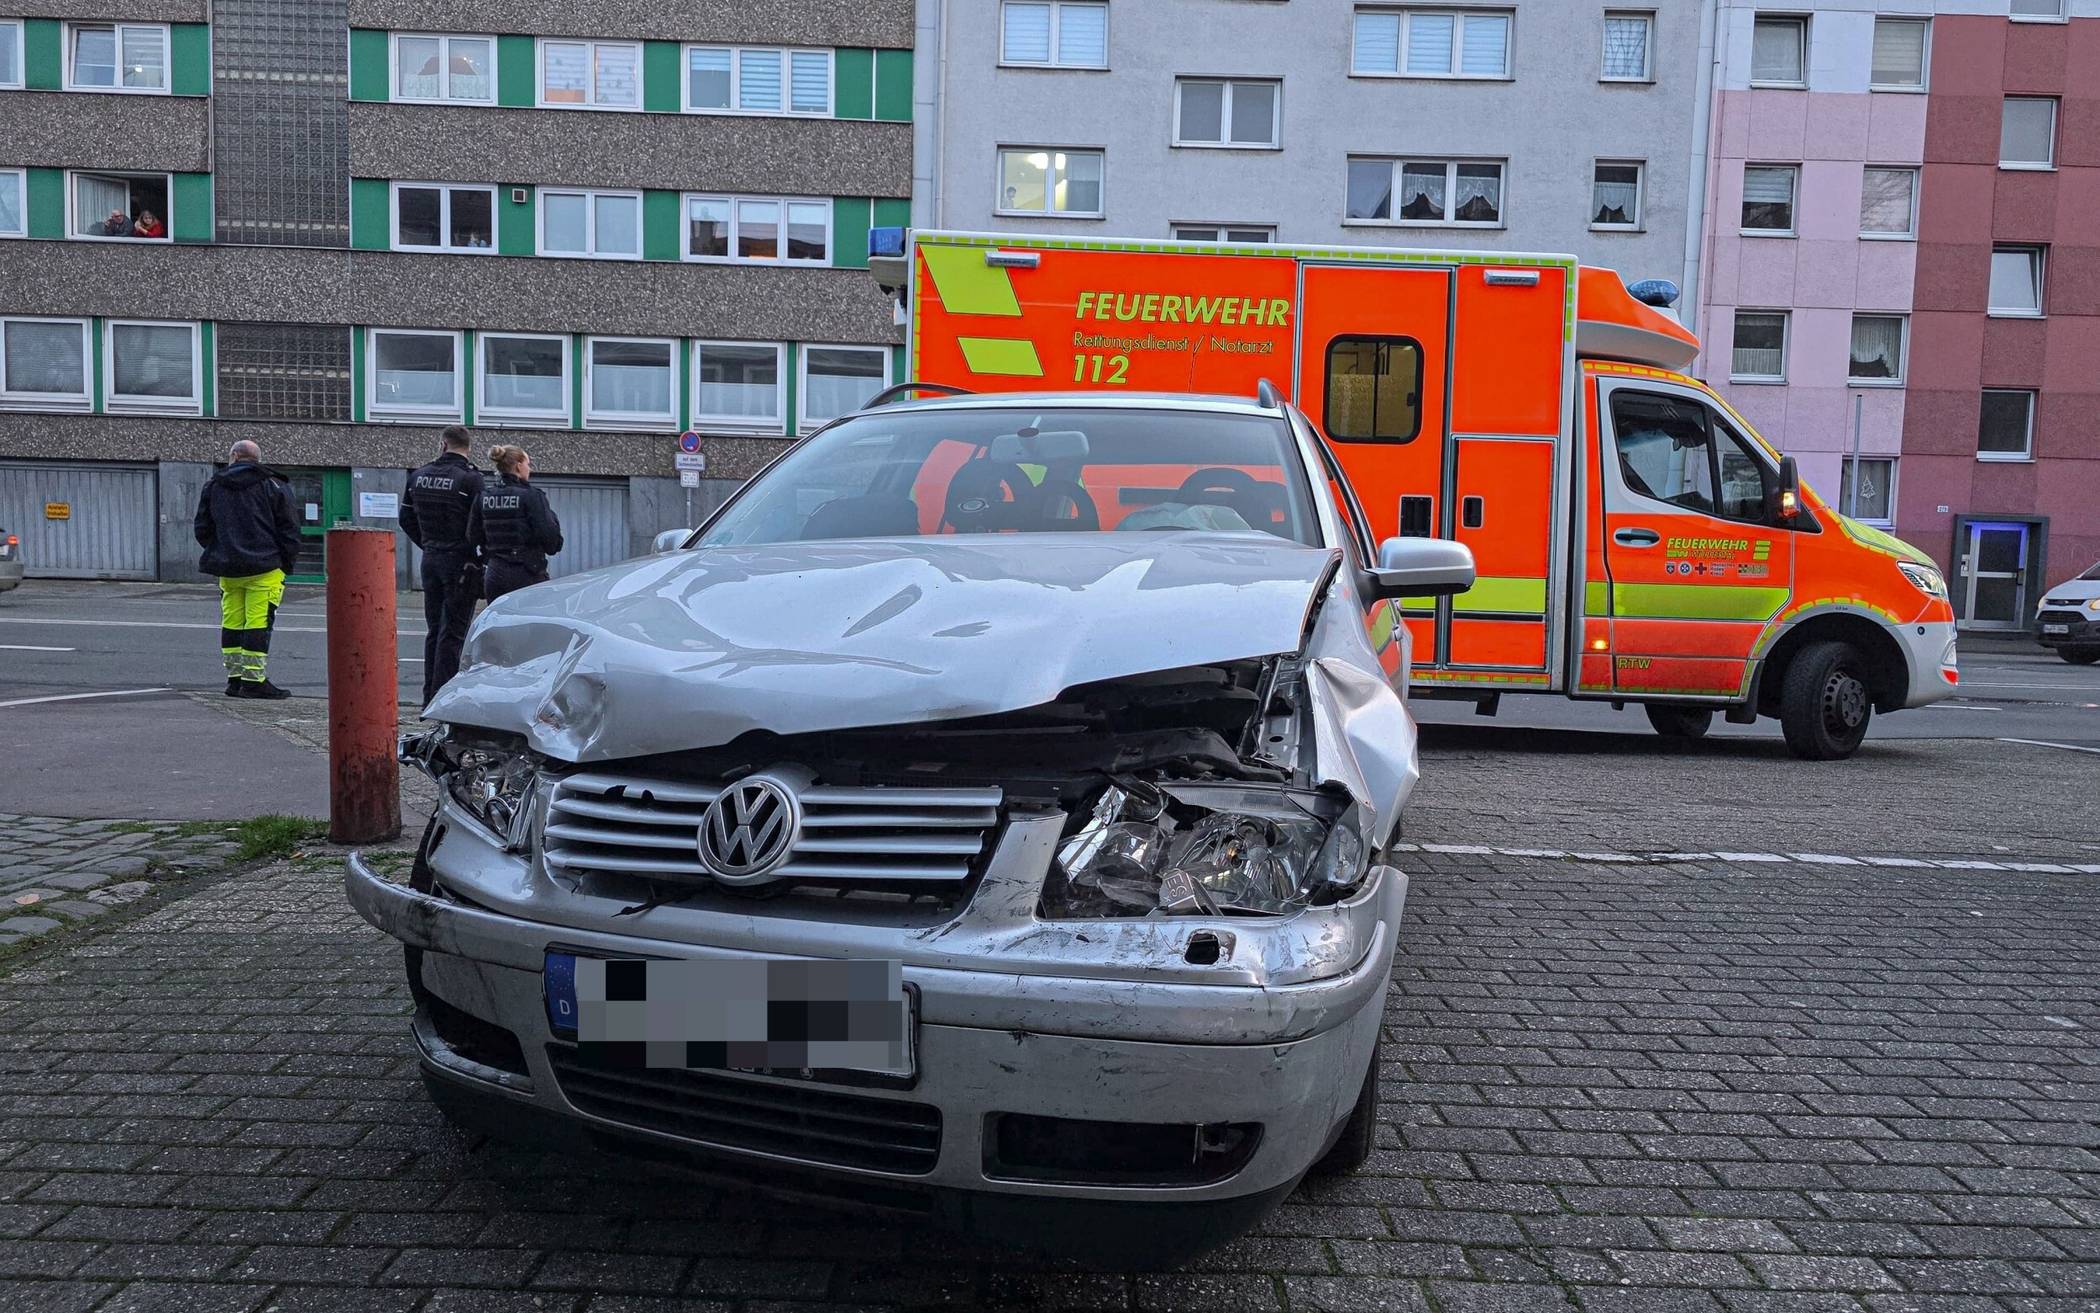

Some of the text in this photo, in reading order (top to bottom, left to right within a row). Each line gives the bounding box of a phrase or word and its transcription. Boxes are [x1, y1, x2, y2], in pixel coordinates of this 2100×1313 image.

[1075, 292, 1290, 326] FEUERWEHR
[1073, 331, 1189, 353] Rettungsdienst
[1211, 336, 1273, 353] Notarzt
[1073, 354, 1129, 384] 112
[415, 476, 454, 490] POLIZEI
[482, 496, 519, 509] POLIZEI
[1666, 538, 1748, 550] FEUERWEHR
[1618, 658, 1651, 669] RTW
[559, 999, 570, 1015] D
